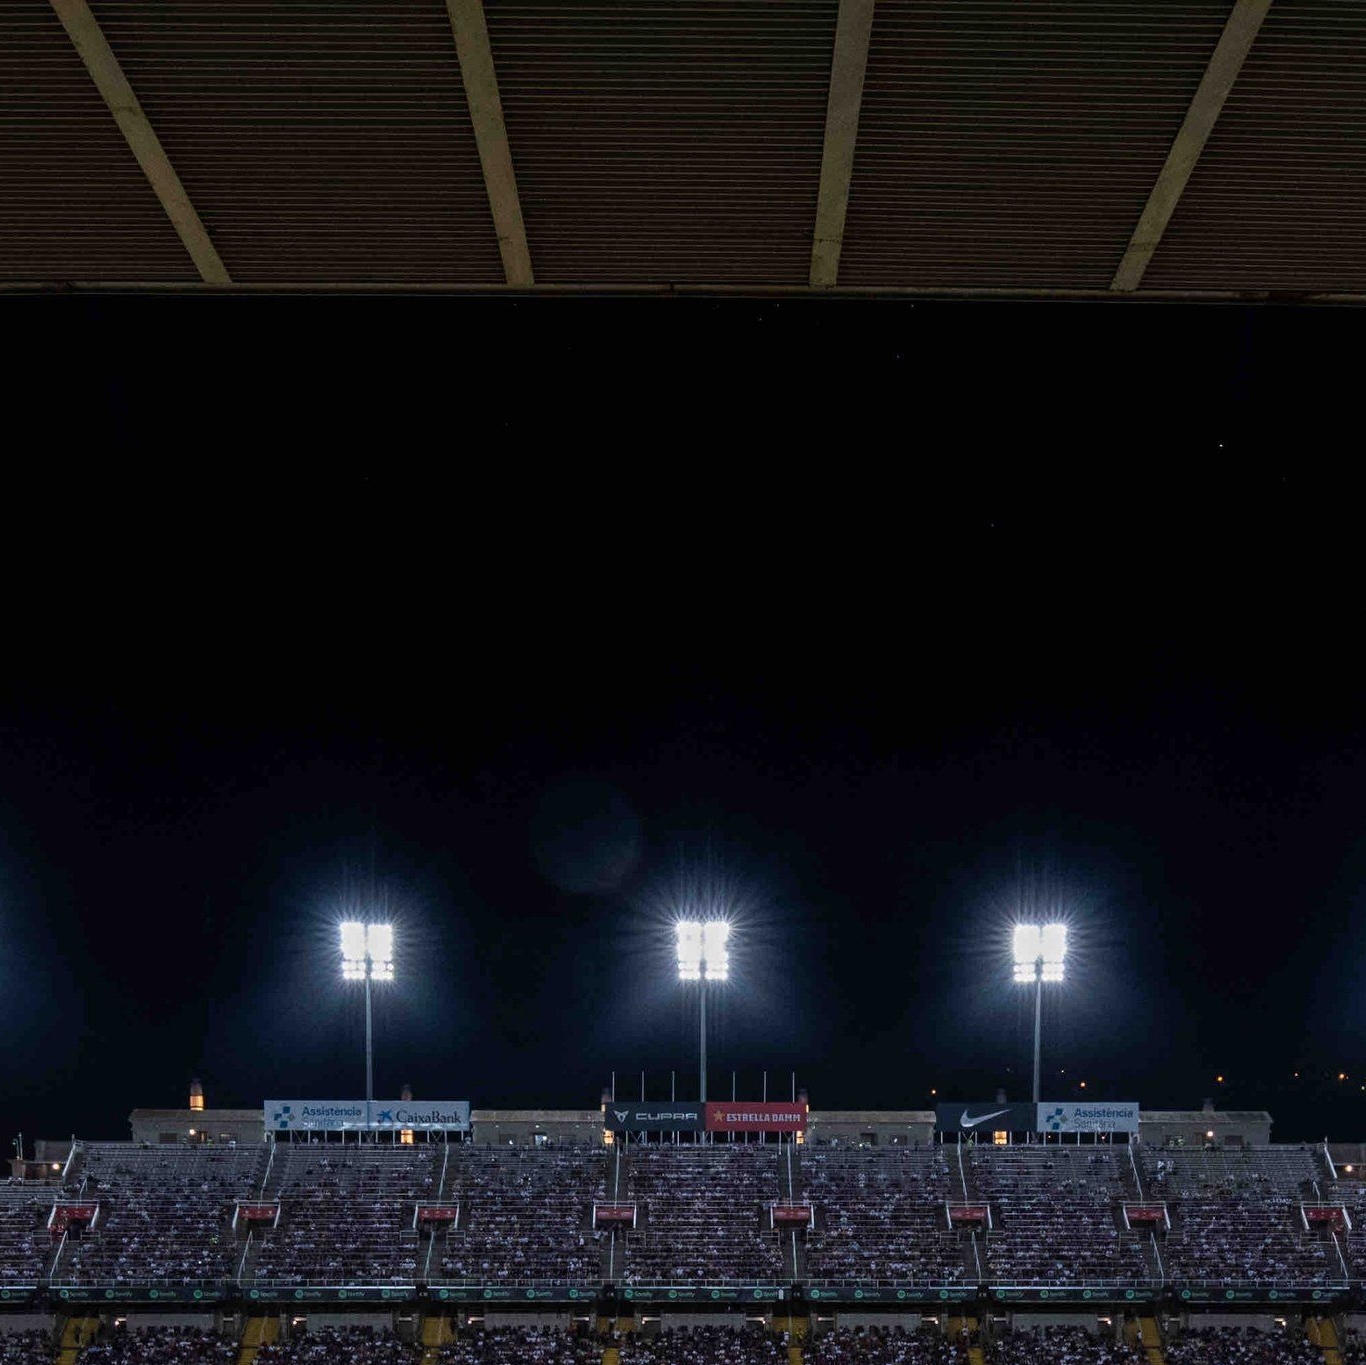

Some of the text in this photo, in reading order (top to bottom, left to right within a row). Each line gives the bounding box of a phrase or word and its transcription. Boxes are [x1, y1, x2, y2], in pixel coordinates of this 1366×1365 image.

[396, 1110, 462, 1124] CaixaBank
[635, 1112, 698, 1121] CUPRA
[726, 1114, 801, 1122] ESTRELLA DAMM
